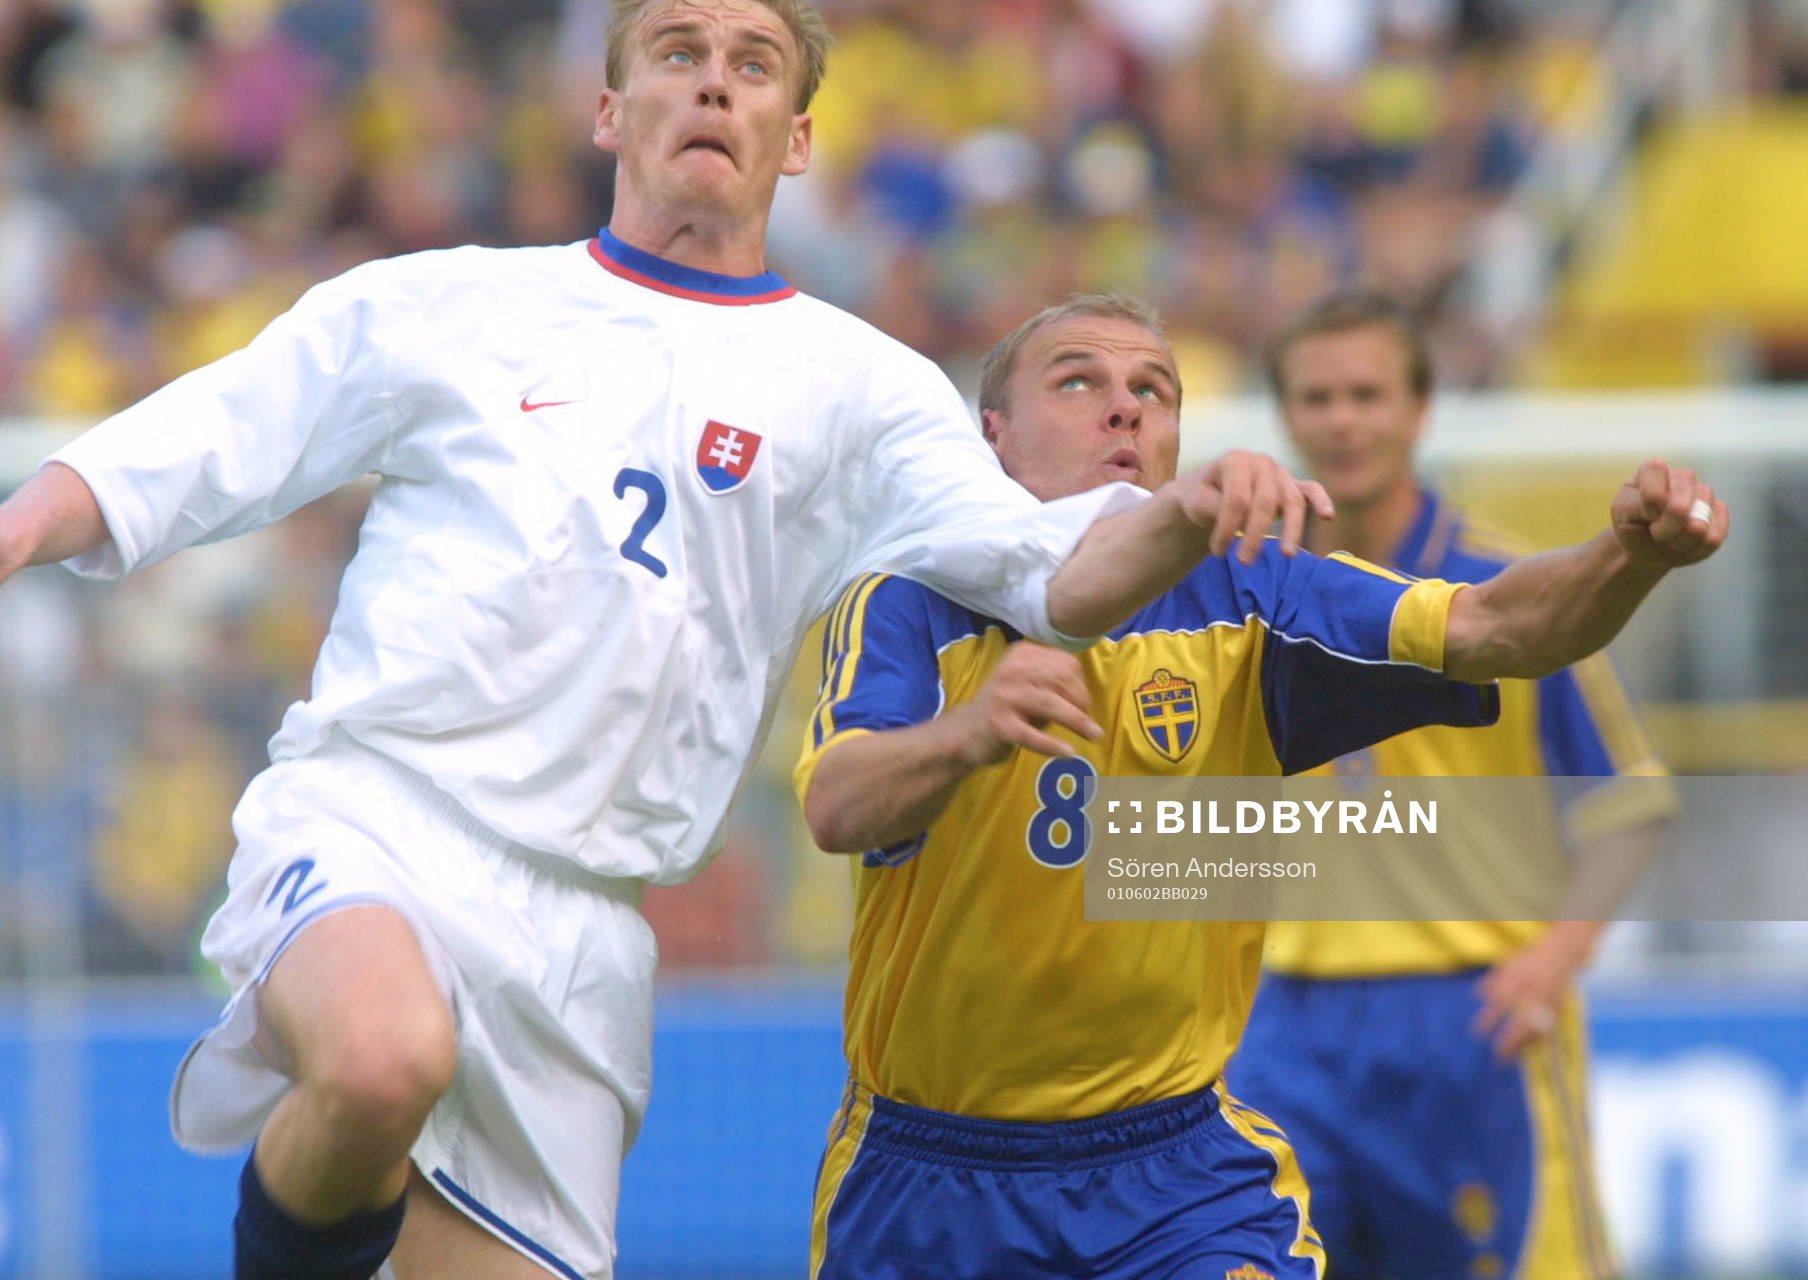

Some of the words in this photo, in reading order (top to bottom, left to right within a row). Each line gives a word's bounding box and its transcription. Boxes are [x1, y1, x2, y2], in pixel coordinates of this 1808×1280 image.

[613, 467, 668, 579] 2
[1026, 754, 1098, 869] 8
[265, 859, 328, 916] 2
